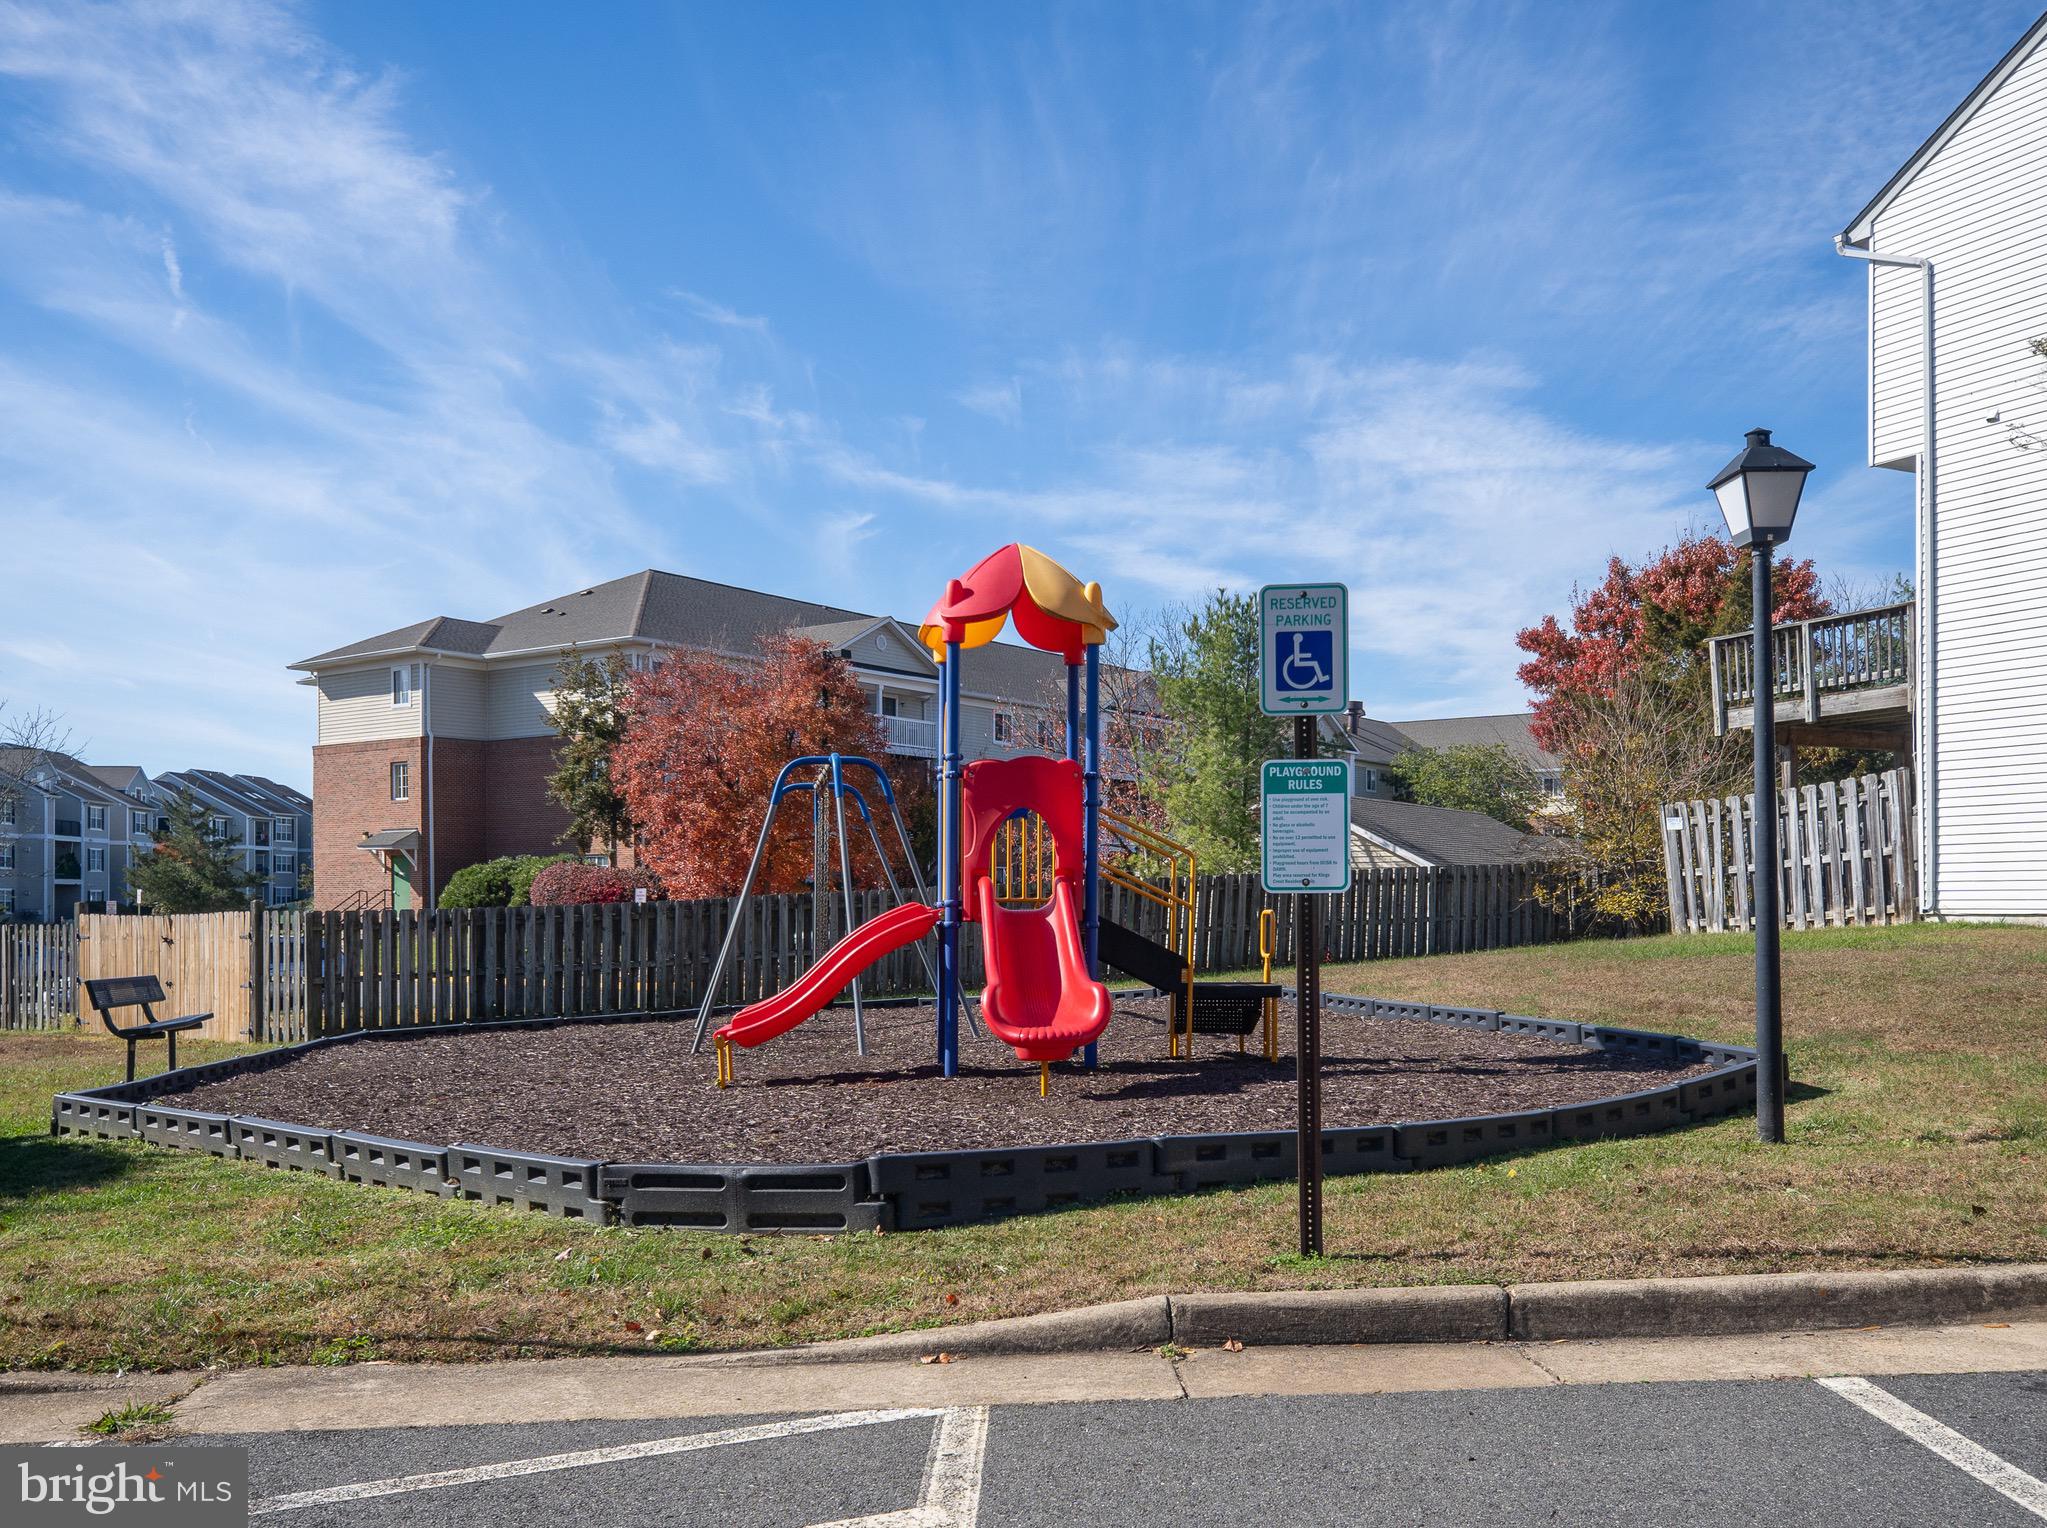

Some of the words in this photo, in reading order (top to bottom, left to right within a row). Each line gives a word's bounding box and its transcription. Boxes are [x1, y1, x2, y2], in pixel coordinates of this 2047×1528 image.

[1270, 596, 1337, 610] RESERVED
[1275, 613, 1332, 627] PARKING
[1288, 779, 1323, 790] RULES
